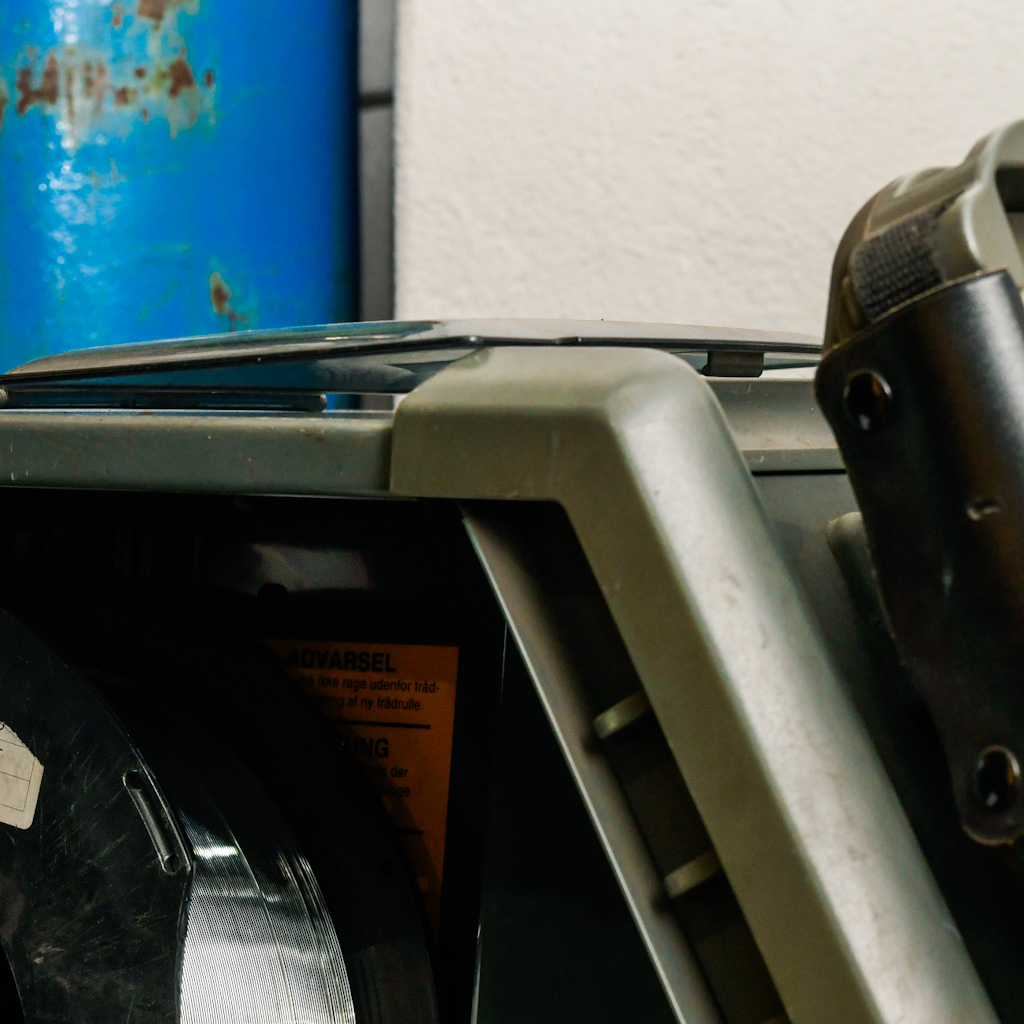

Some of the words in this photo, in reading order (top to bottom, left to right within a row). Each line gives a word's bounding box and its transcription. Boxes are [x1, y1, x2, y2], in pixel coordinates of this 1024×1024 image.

[286, 648, 397, 672] ADVARSEL
[319, 676, 339, 688] ikke
[342, 679, 367, 692] rage
[370, 679, 413, 692] udenfor
[348, 696, 359, 708] af
[362, 698, 375, 711] ny
[390, 766, 409, 778] der
